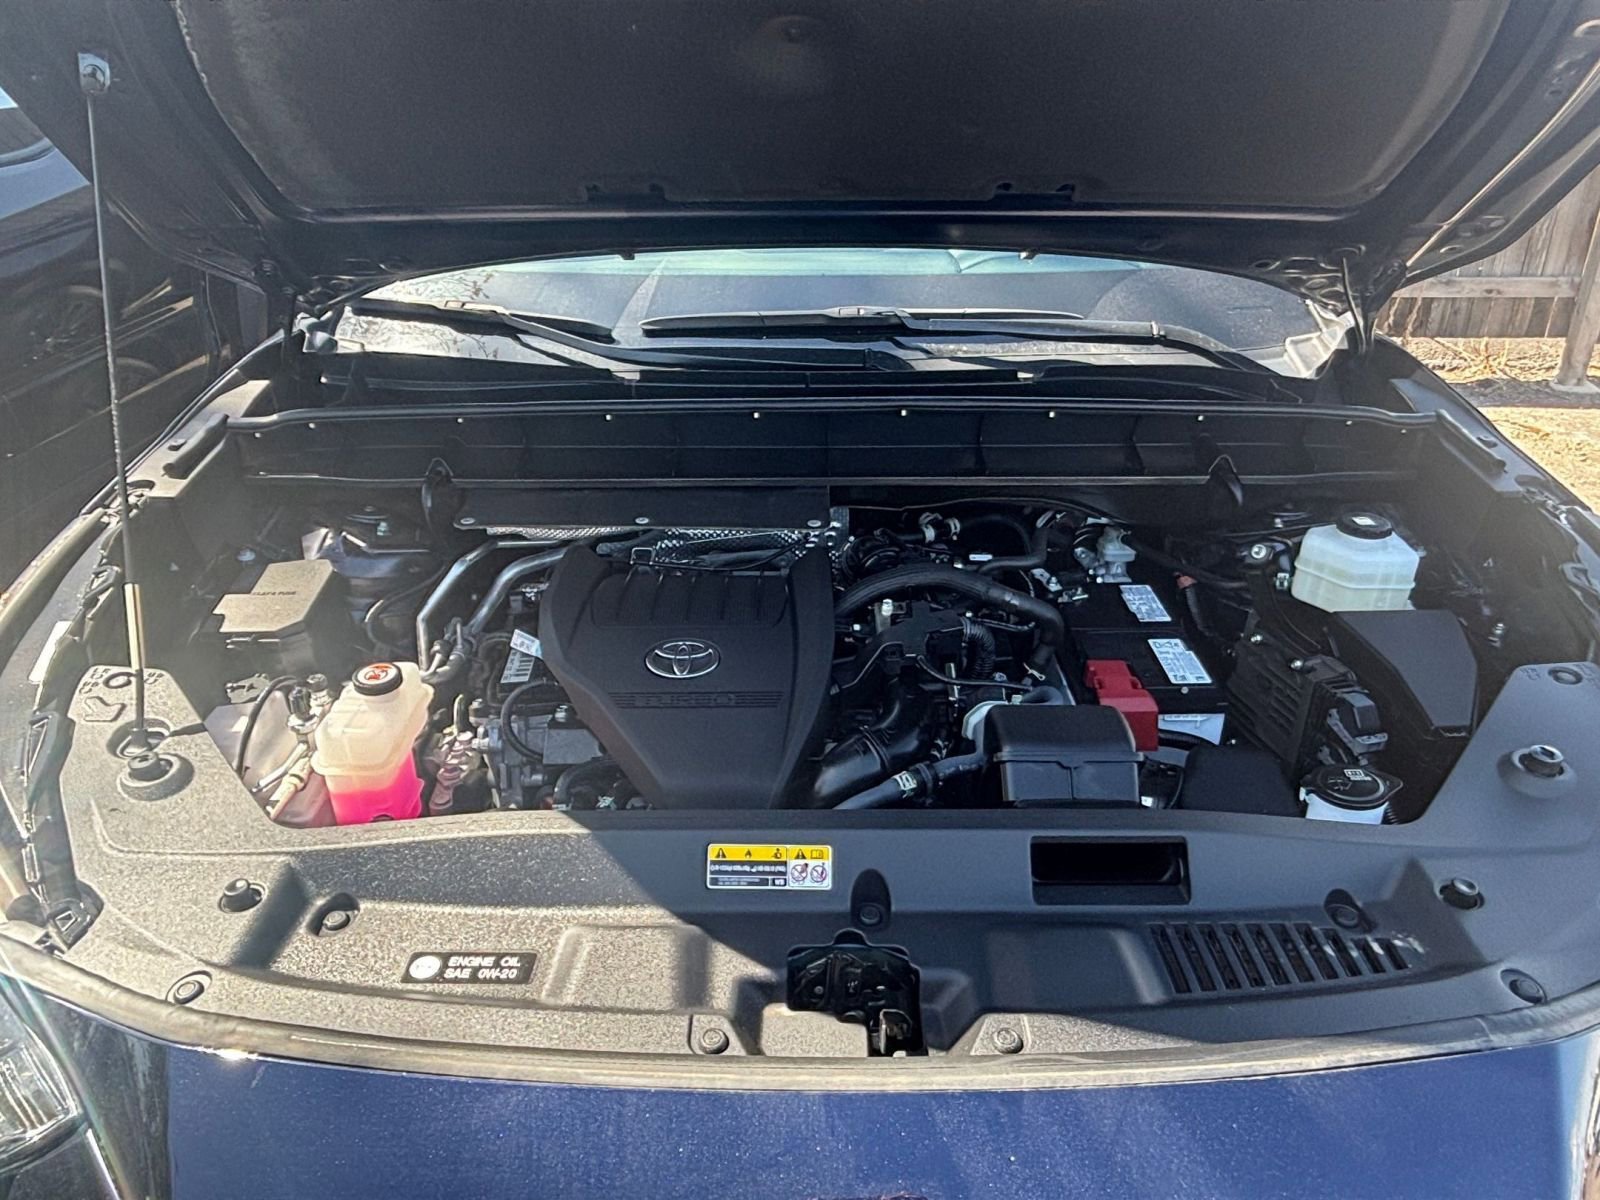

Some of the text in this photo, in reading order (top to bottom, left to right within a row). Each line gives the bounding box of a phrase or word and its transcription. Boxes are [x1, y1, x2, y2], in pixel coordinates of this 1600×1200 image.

[448, 956, 521, 967] ENGINE OIL
[443, 968, 518, 979] SAE 0W-20
